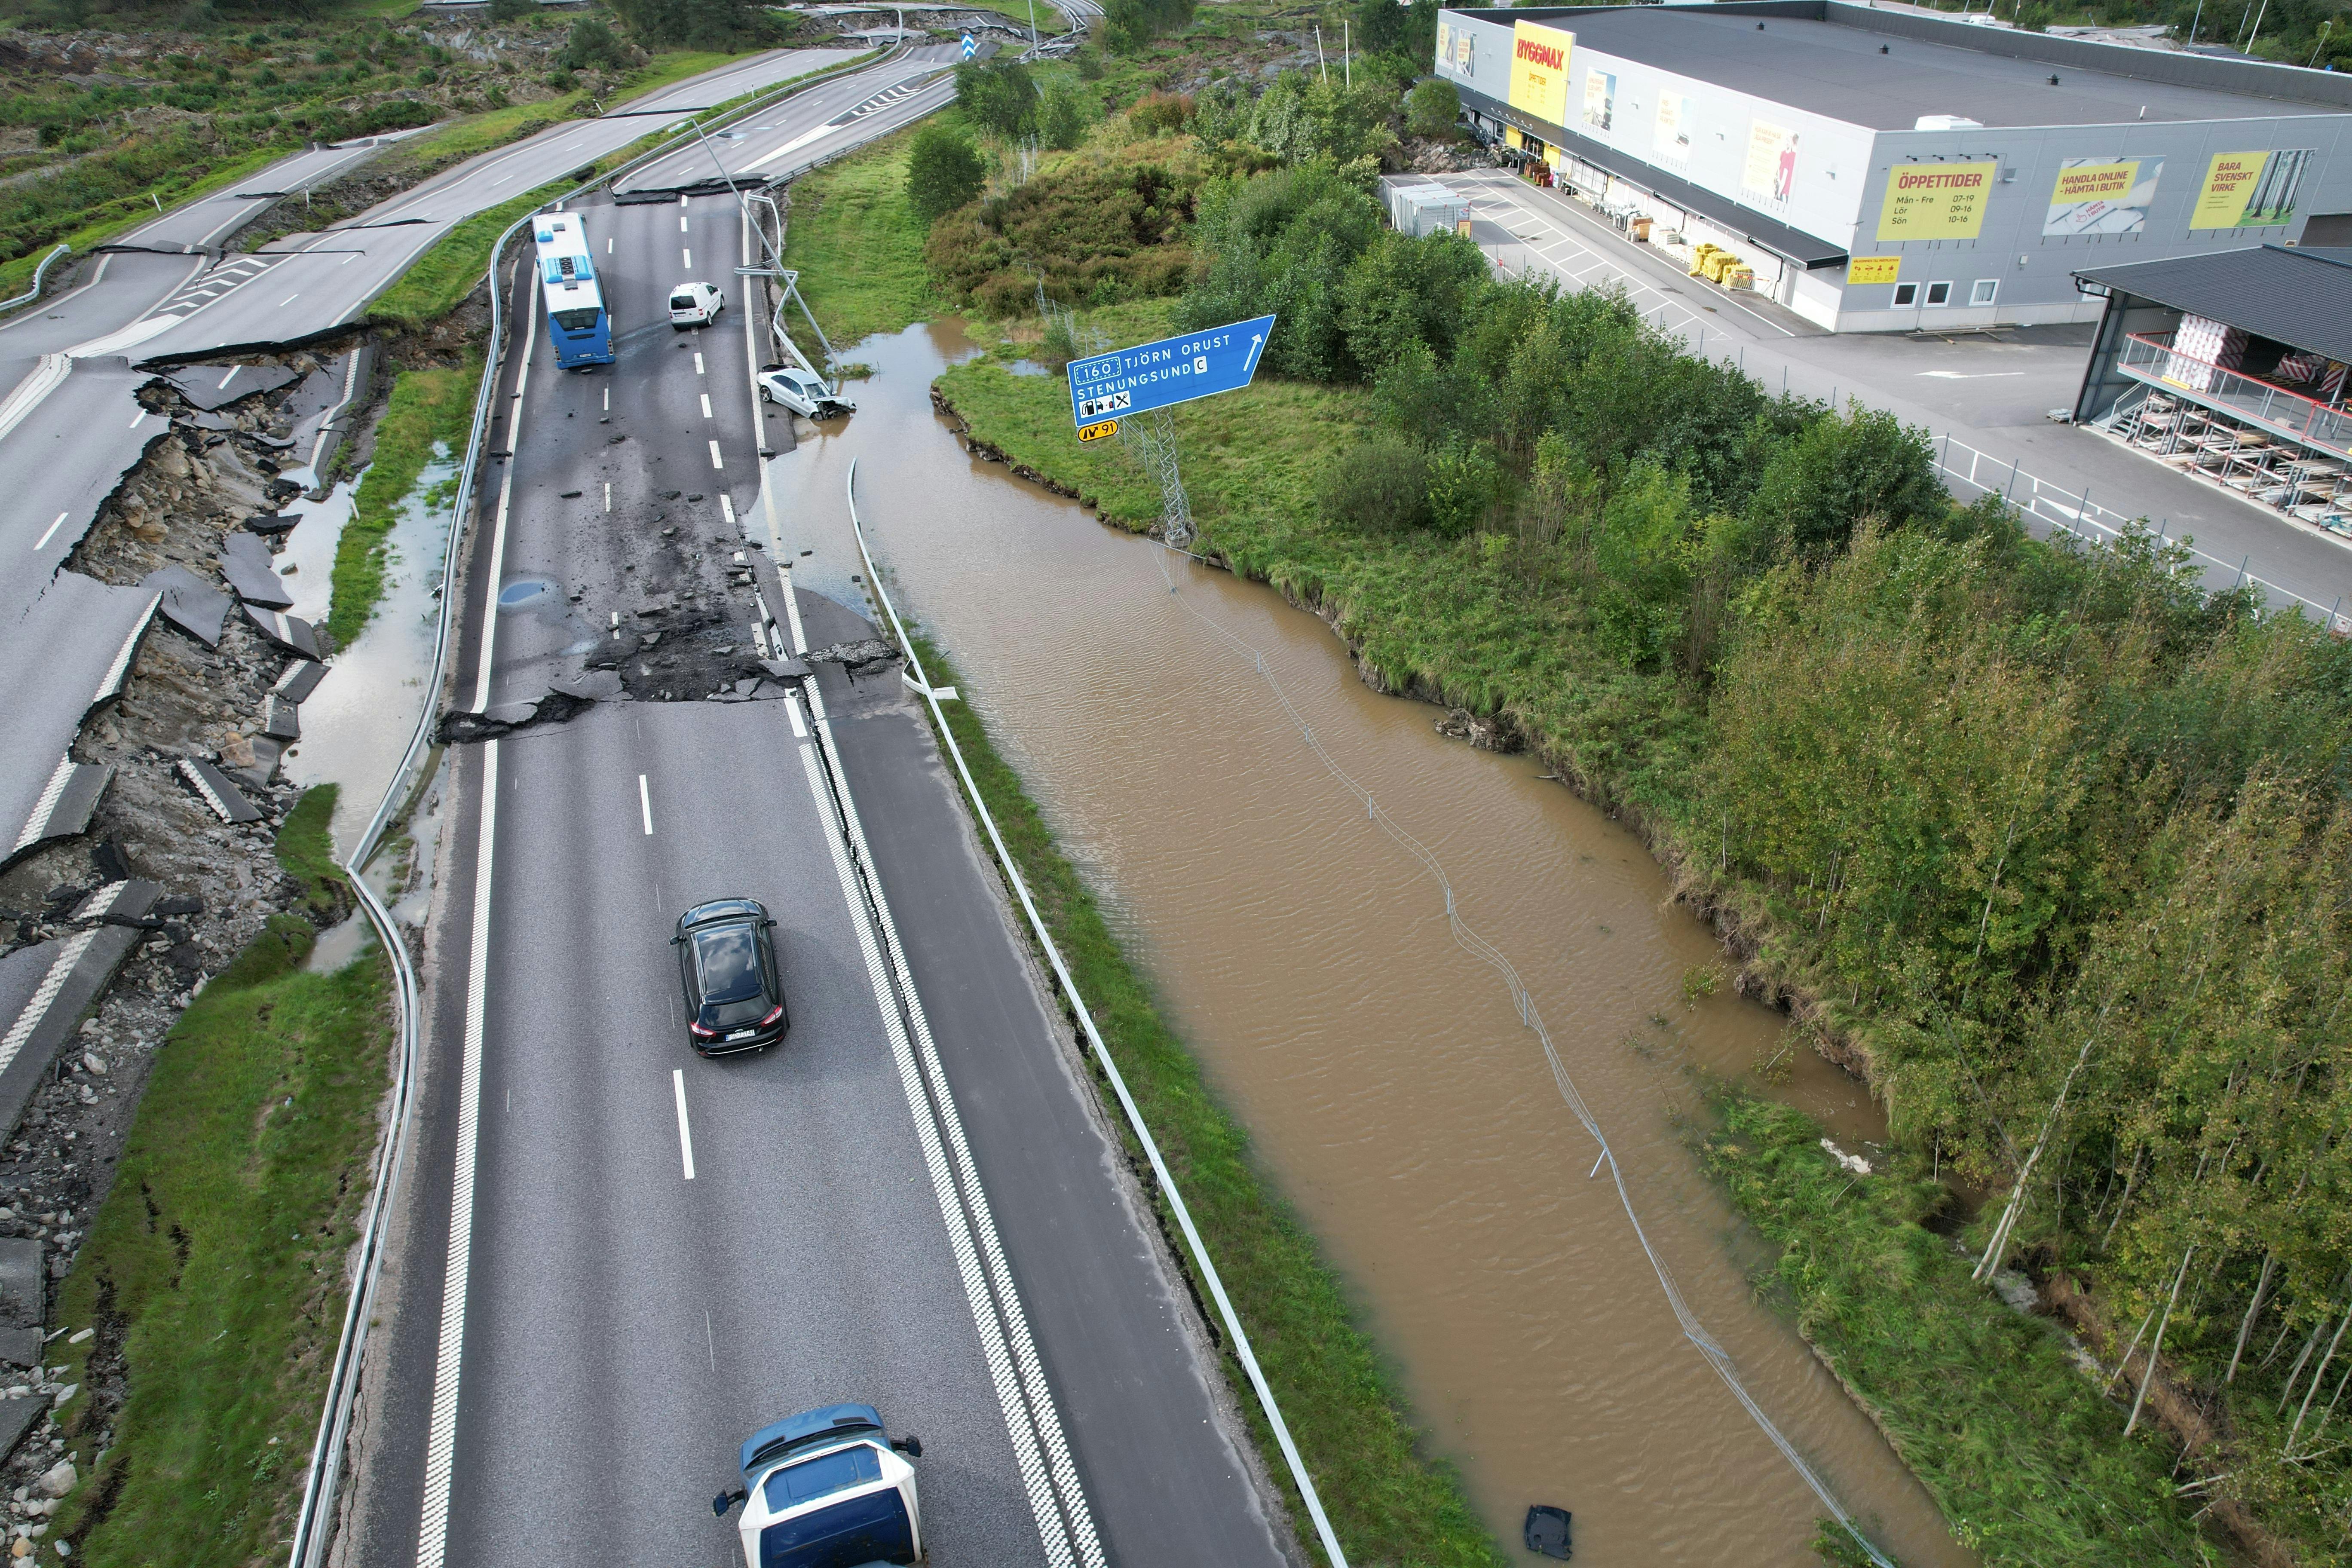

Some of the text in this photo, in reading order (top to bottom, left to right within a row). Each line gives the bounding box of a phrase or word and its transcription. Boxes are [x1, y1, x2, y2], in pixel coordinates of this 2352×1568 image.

[1517, 38, 1564, 71] BYGGMAX
[2217, 162, 2241, 171] BARA
[1898, 172, 1982, 189] ÖPPETTIDER
[2062, 171, 2128, 184] HANDLA ONLINE
[2214, 172, 2254, 182] SVENSKT
[2064, 184, 2094, 194] HÄMTA
[2100, 181, 2125, 191] BUTIK
[2211, 183, 2236, 192] VIRKE
[2086, 201, 2104, 212] HÄMTA
[2091, 205, 2106, 216] BUTIK
[1084, 335, 1230, 379] 160 TJÖRN ORUST
[1077, 359, 1204, 400] STENUNGSUND C
[1102, 424, 1115, 435] 91
